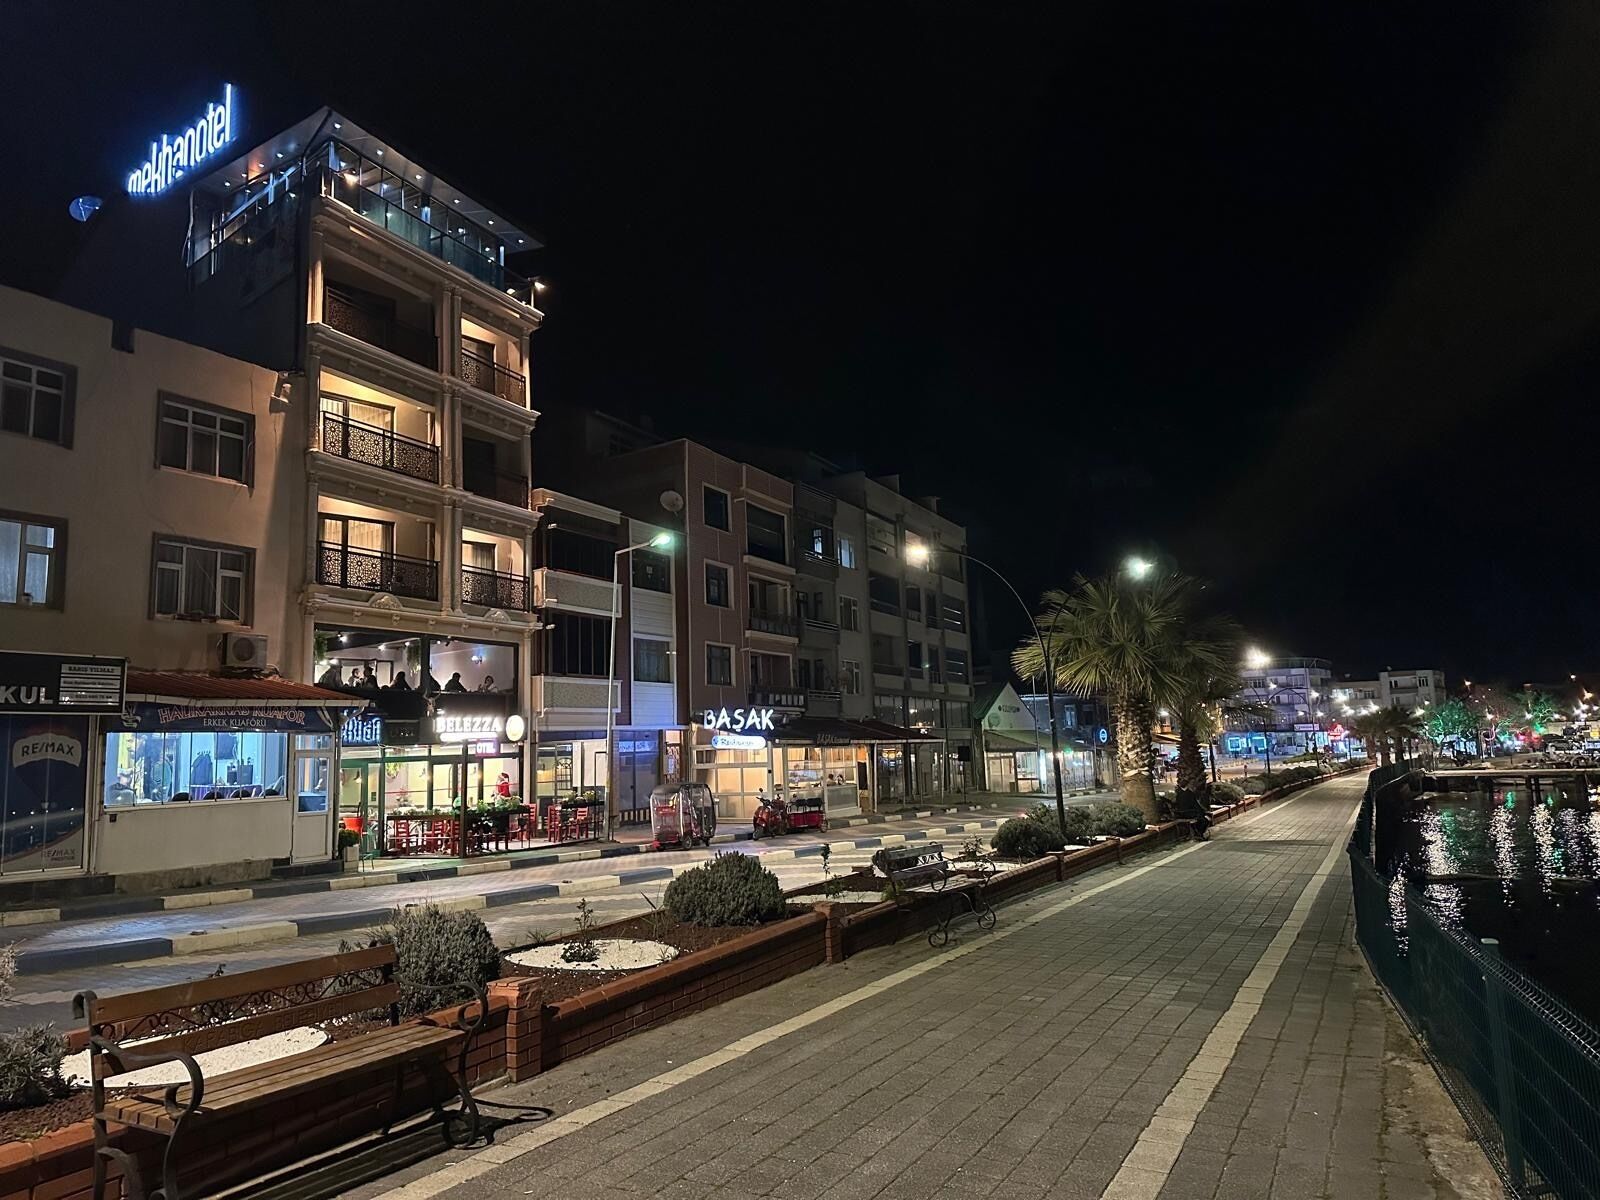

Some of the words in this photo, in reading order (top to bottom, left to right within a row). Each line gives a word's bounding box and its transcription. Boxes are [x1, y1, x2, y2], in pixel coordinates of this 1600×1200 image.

[127, 83, 231, 193] mekhanotel
[203, 718, 228, 727] ERKEK
[229, 717, 267, 728] KUAFÖRÜ
[436, 716, 503, 732] BELEZZA
[703, 707, 775, 732] BAŞAK
[21, 742, 75, 757] RE/MAX
